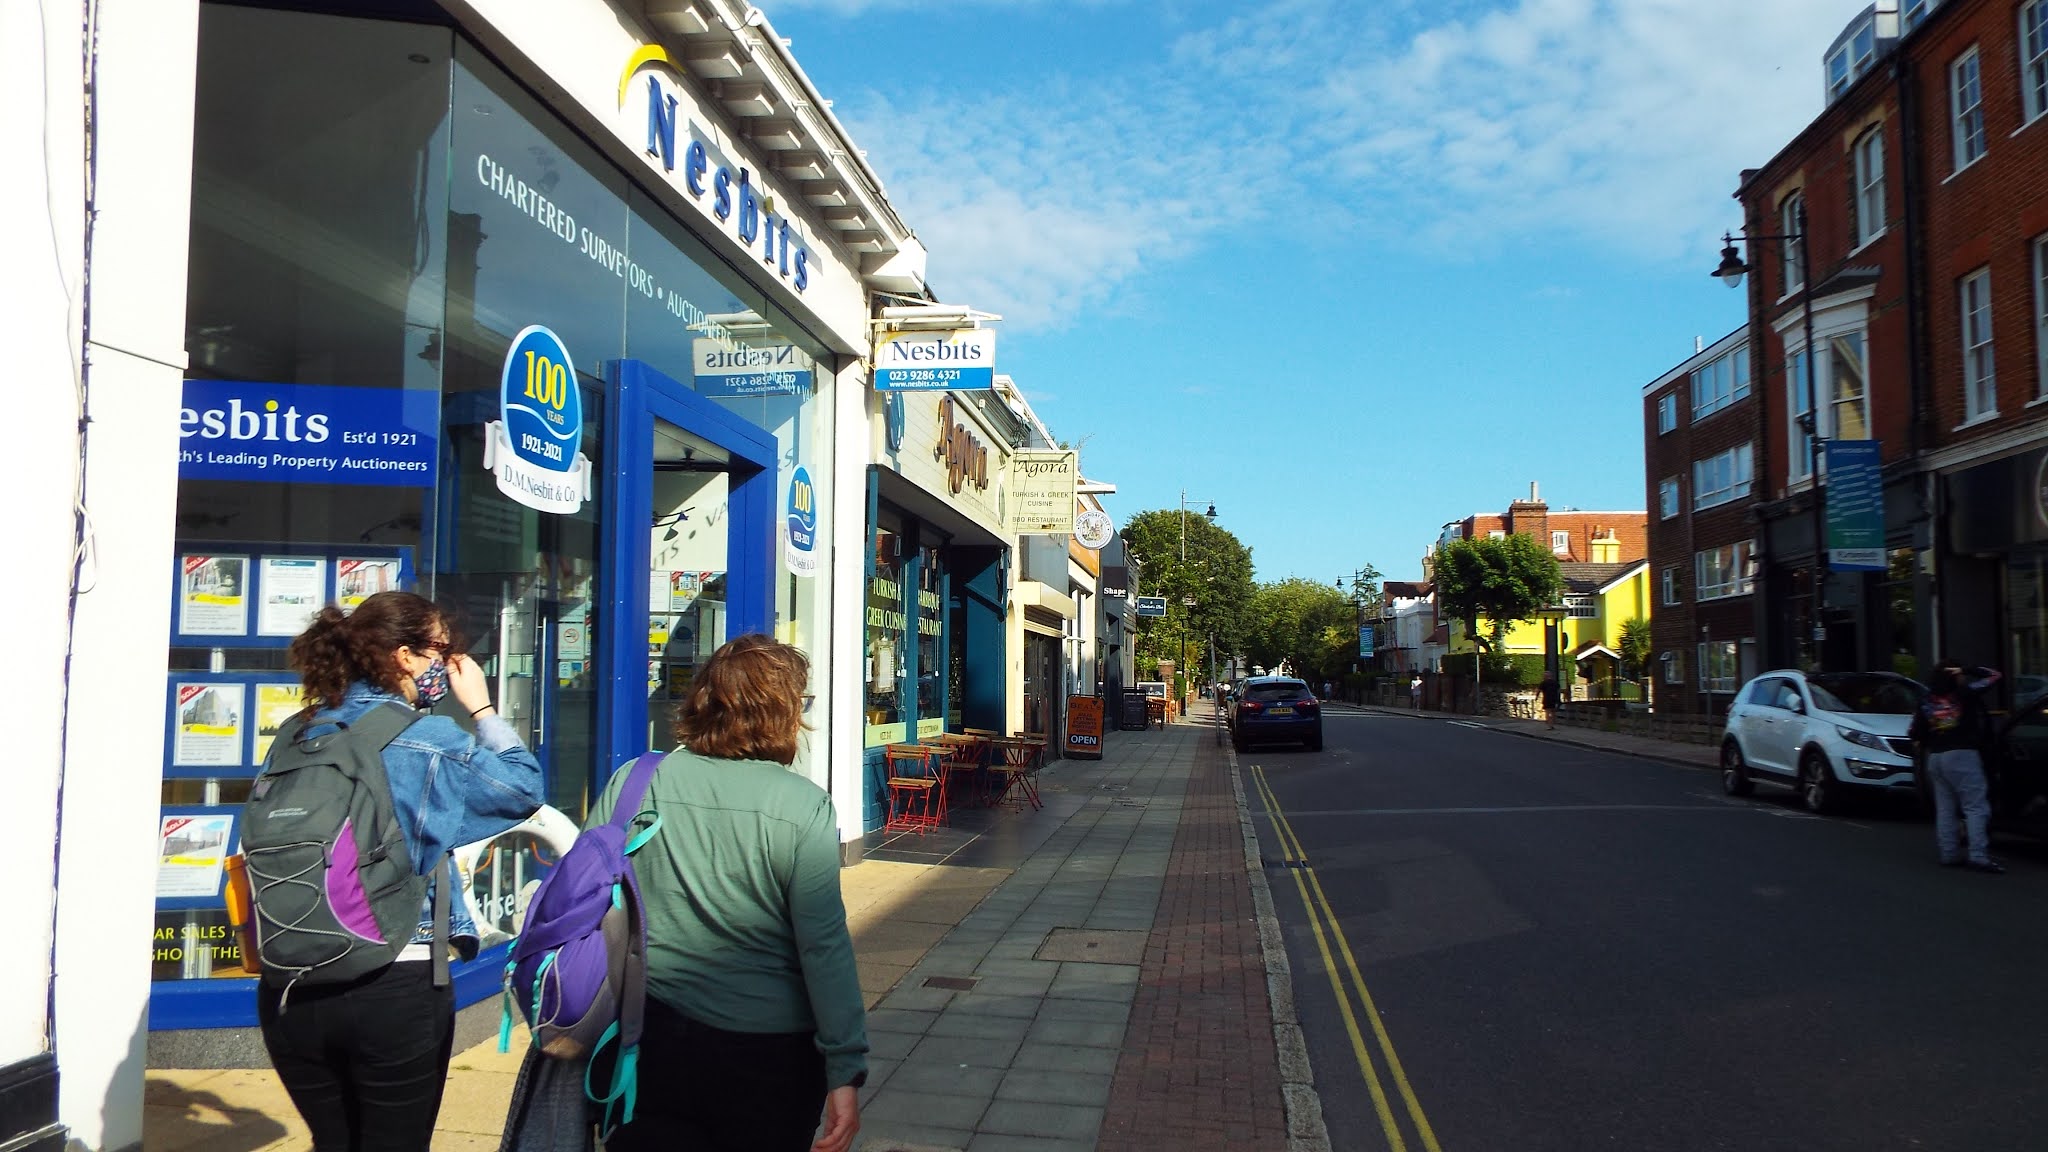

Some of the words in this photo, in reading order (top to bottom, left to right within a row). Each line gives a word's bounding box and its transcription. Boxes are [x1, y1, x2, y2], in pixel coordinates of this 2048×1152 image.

[646, 75, 808, 291] Nesbits
[477, 154, 576, 243] CHARTERED
[580, 227, 654, 298] SURVEYORS
[667, 290, 732, 352] AUCTIONEERS
[892, 339, 981, 361] Nesbits
[524, 350, 567, 411] 100
[889, 371, 908, 381] 023
[910, 370, 935, 381] 9286
[937, 369, 961, 380] 4321
[889, 380, 949, 388] www.nesbits.co.uk
[546, 409, 565, 426] YEARS
[343, 431, 377, 444] Est'd
[382, 432, 417, 446] 1921
[521, 432, 562, 462] 1921-2021
[208, 451, 267, 468] Leading
[273, 454, 338, 471] Property
[341, 456, 428, 472] Auctioneers
[1013, 460, 1069, 478] Agora
[556, 486, 563, 502] &
[564, 486, 575, 502] Co
[794, 480, 812, 513] 100
[873, 577, 897, 600] TURKISH
[1103, 587, 1127, 596] Shape
[181, 685, 199, 701] SOLD
[1070, 735, 1097, 745] OPEN
[164, 818, 186, 833] SOLD
[180, 926, 226, 939] SALES
[210, 946, 241, 959] THE
